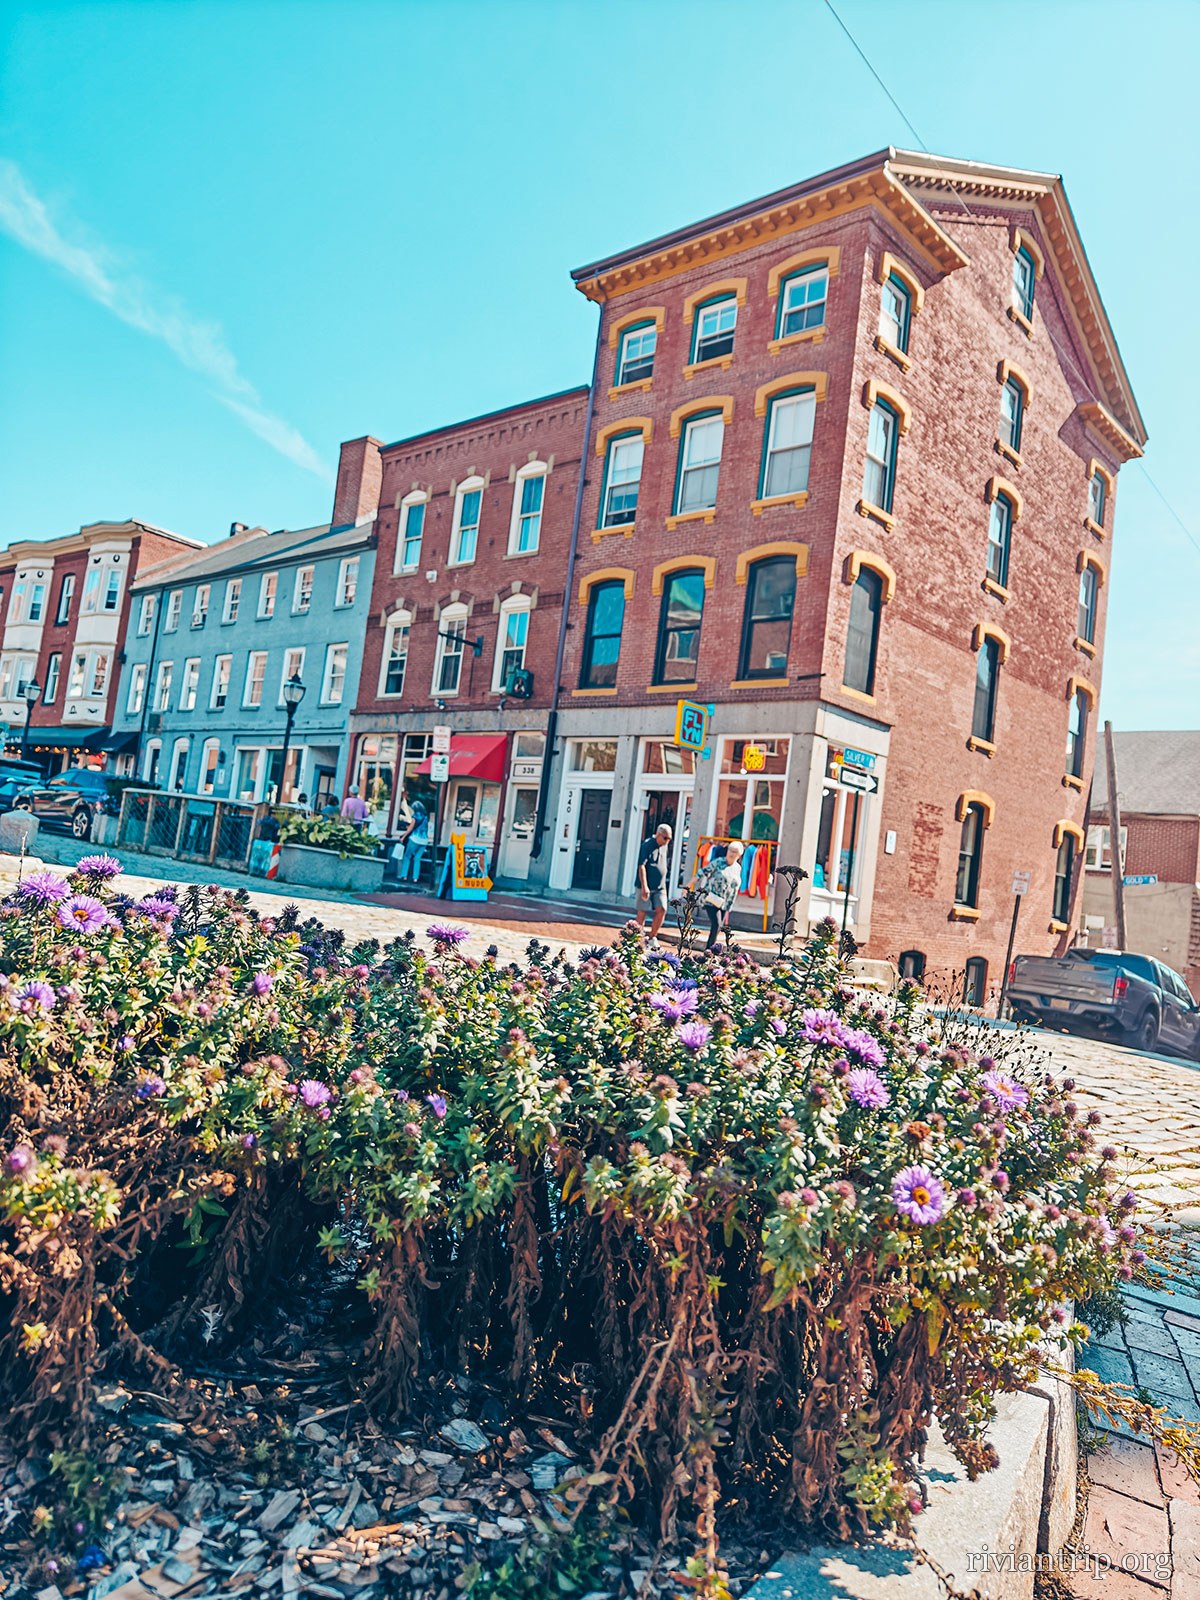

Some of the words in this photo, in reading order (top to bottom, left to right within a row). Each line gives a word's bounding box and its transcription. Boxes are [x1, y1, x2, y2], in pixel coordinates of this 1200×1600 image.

[685, 711, 701, 728] FL
[684, 726, 701, 743] YN
[846, 750, 865, 764] SILVER
[1126, 876, 1143, 885] GOLD
